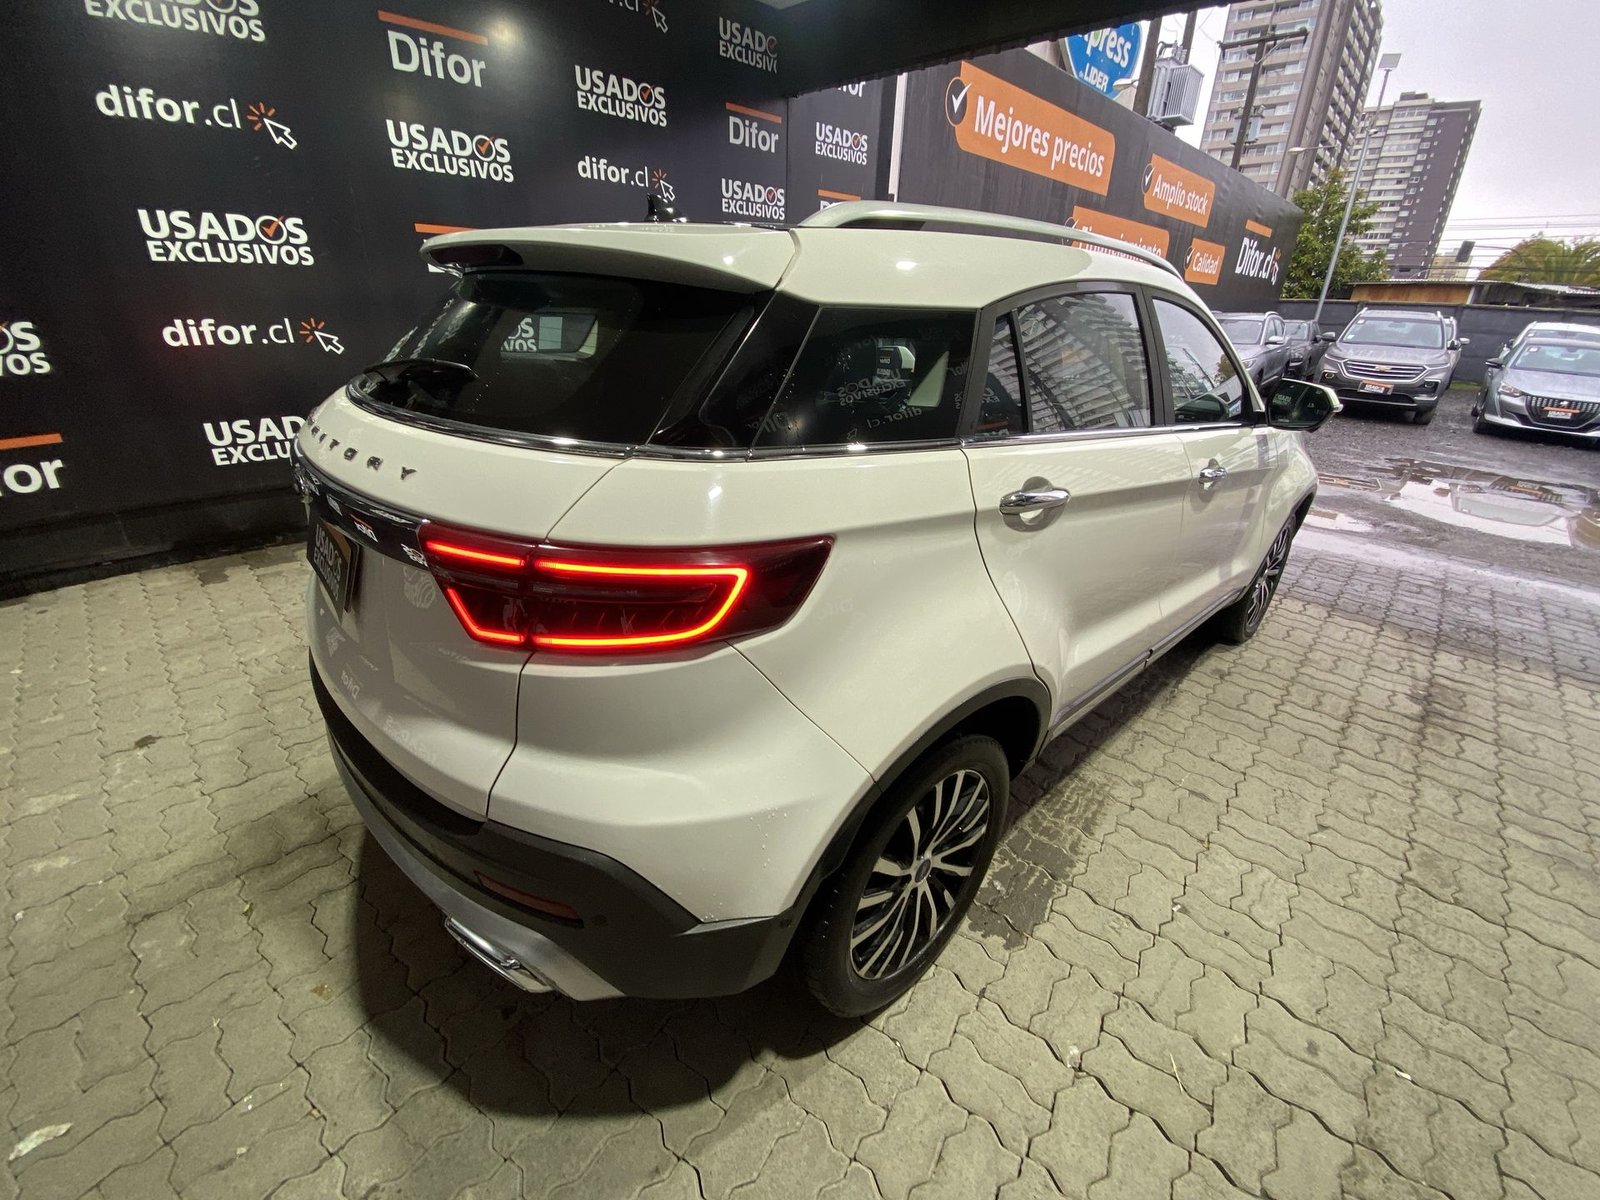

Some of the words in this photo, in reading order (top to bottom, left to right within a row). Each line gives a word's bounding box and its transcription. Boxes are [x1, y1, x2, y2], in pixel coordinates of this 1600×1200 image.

[84, 0, 266, 42] EXCLUSIVOS
[719, 16, 778, 58] USADO
[387, 30, 486, 88] Difor
[719, 40, 778, 74] EXCLUSIV
[574, 65, 666, 109] USADOS
[1084, 63, 1109, 93] LIDER
[95, 84, 242, 129] difor.cl
[577, 90, 668, 127] EXCLUSIVOS
[386, 119, 511, 164] USADOS
[728, 115, 779, 153] Difor
[815, 121, 868, 152] USADOS
[974, 96, 1049, 158] Mejores
[1050, 136, 1105, 178] precios
[390, 147, 515, 183] EXCLUSIVOS
[815, 141, 868, 165] EXCLUSIVOS
[577, 156, 649, 187] difor.cl
[721, 178, 785, 206] USADOS
[721, 199, 785, 220] EXCLUSIVOS
[1152, 174, 1187, 210] Amplio
[1185, 190, 1208, 216] stock
[137, 209, 309, 246] USADOS
[146, 240, 315, 266] EXCLUSIVOS
[1192, 251, 1221, 275] Calidad
[1235, 236, 1277, 280] Difor.cl
[162, 318, 295, 347] difor.cl
[203, 416, 306, 447] USAD
